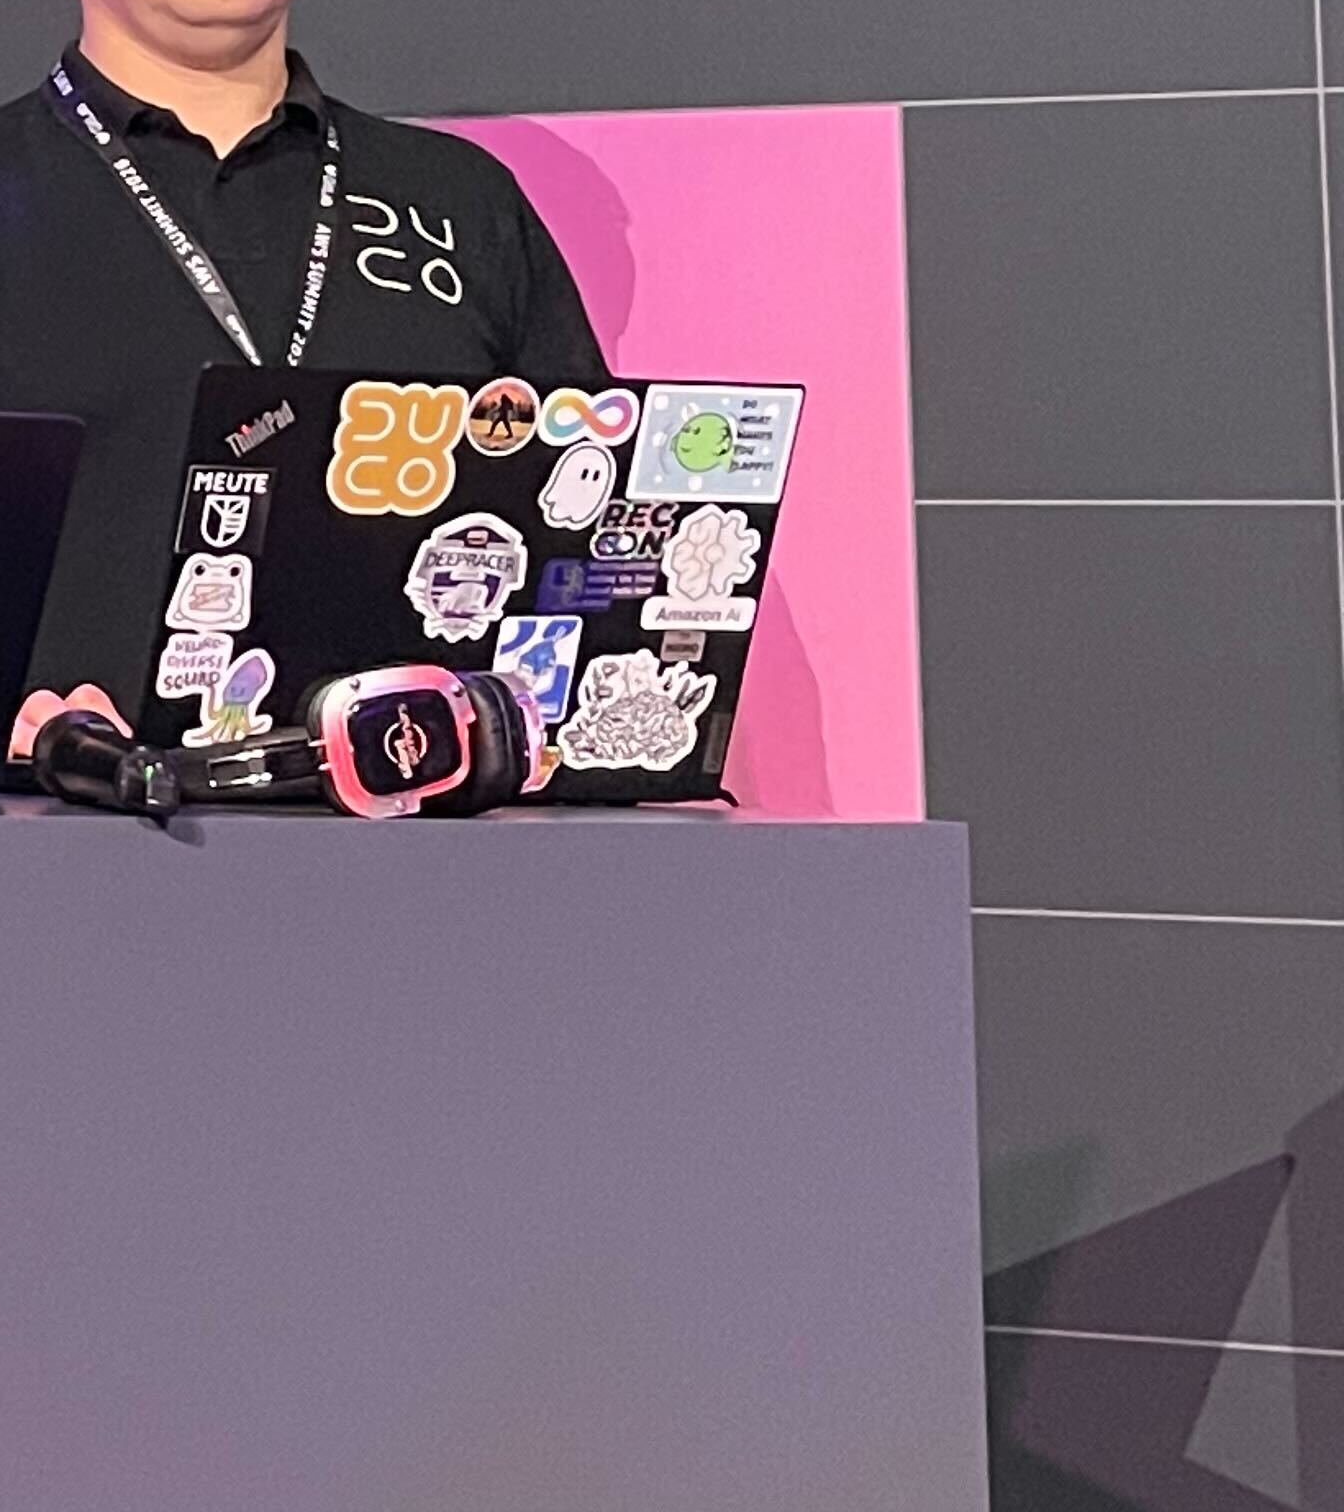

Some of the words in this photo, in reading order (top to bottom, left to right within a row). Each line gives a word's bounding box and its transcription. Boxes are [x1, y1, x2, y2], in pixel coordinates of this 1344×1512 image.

[139, 196, 193, 255] SUMMIT
[311, 223, 332, 258] AWS
[185, 255, 221, 295] AWS
[297, 260, 326, 330] SUMMIT
[224, 399, 295, 458] ThinkPad
[193, 471, 269, 494] MEUTE
[601, 502, 677, 528] REC
[424, 551, 515, 574] DEEPRACER
[655, 607, 721, 622] Amazon
[164, 671, 221, 691] SQUAD
